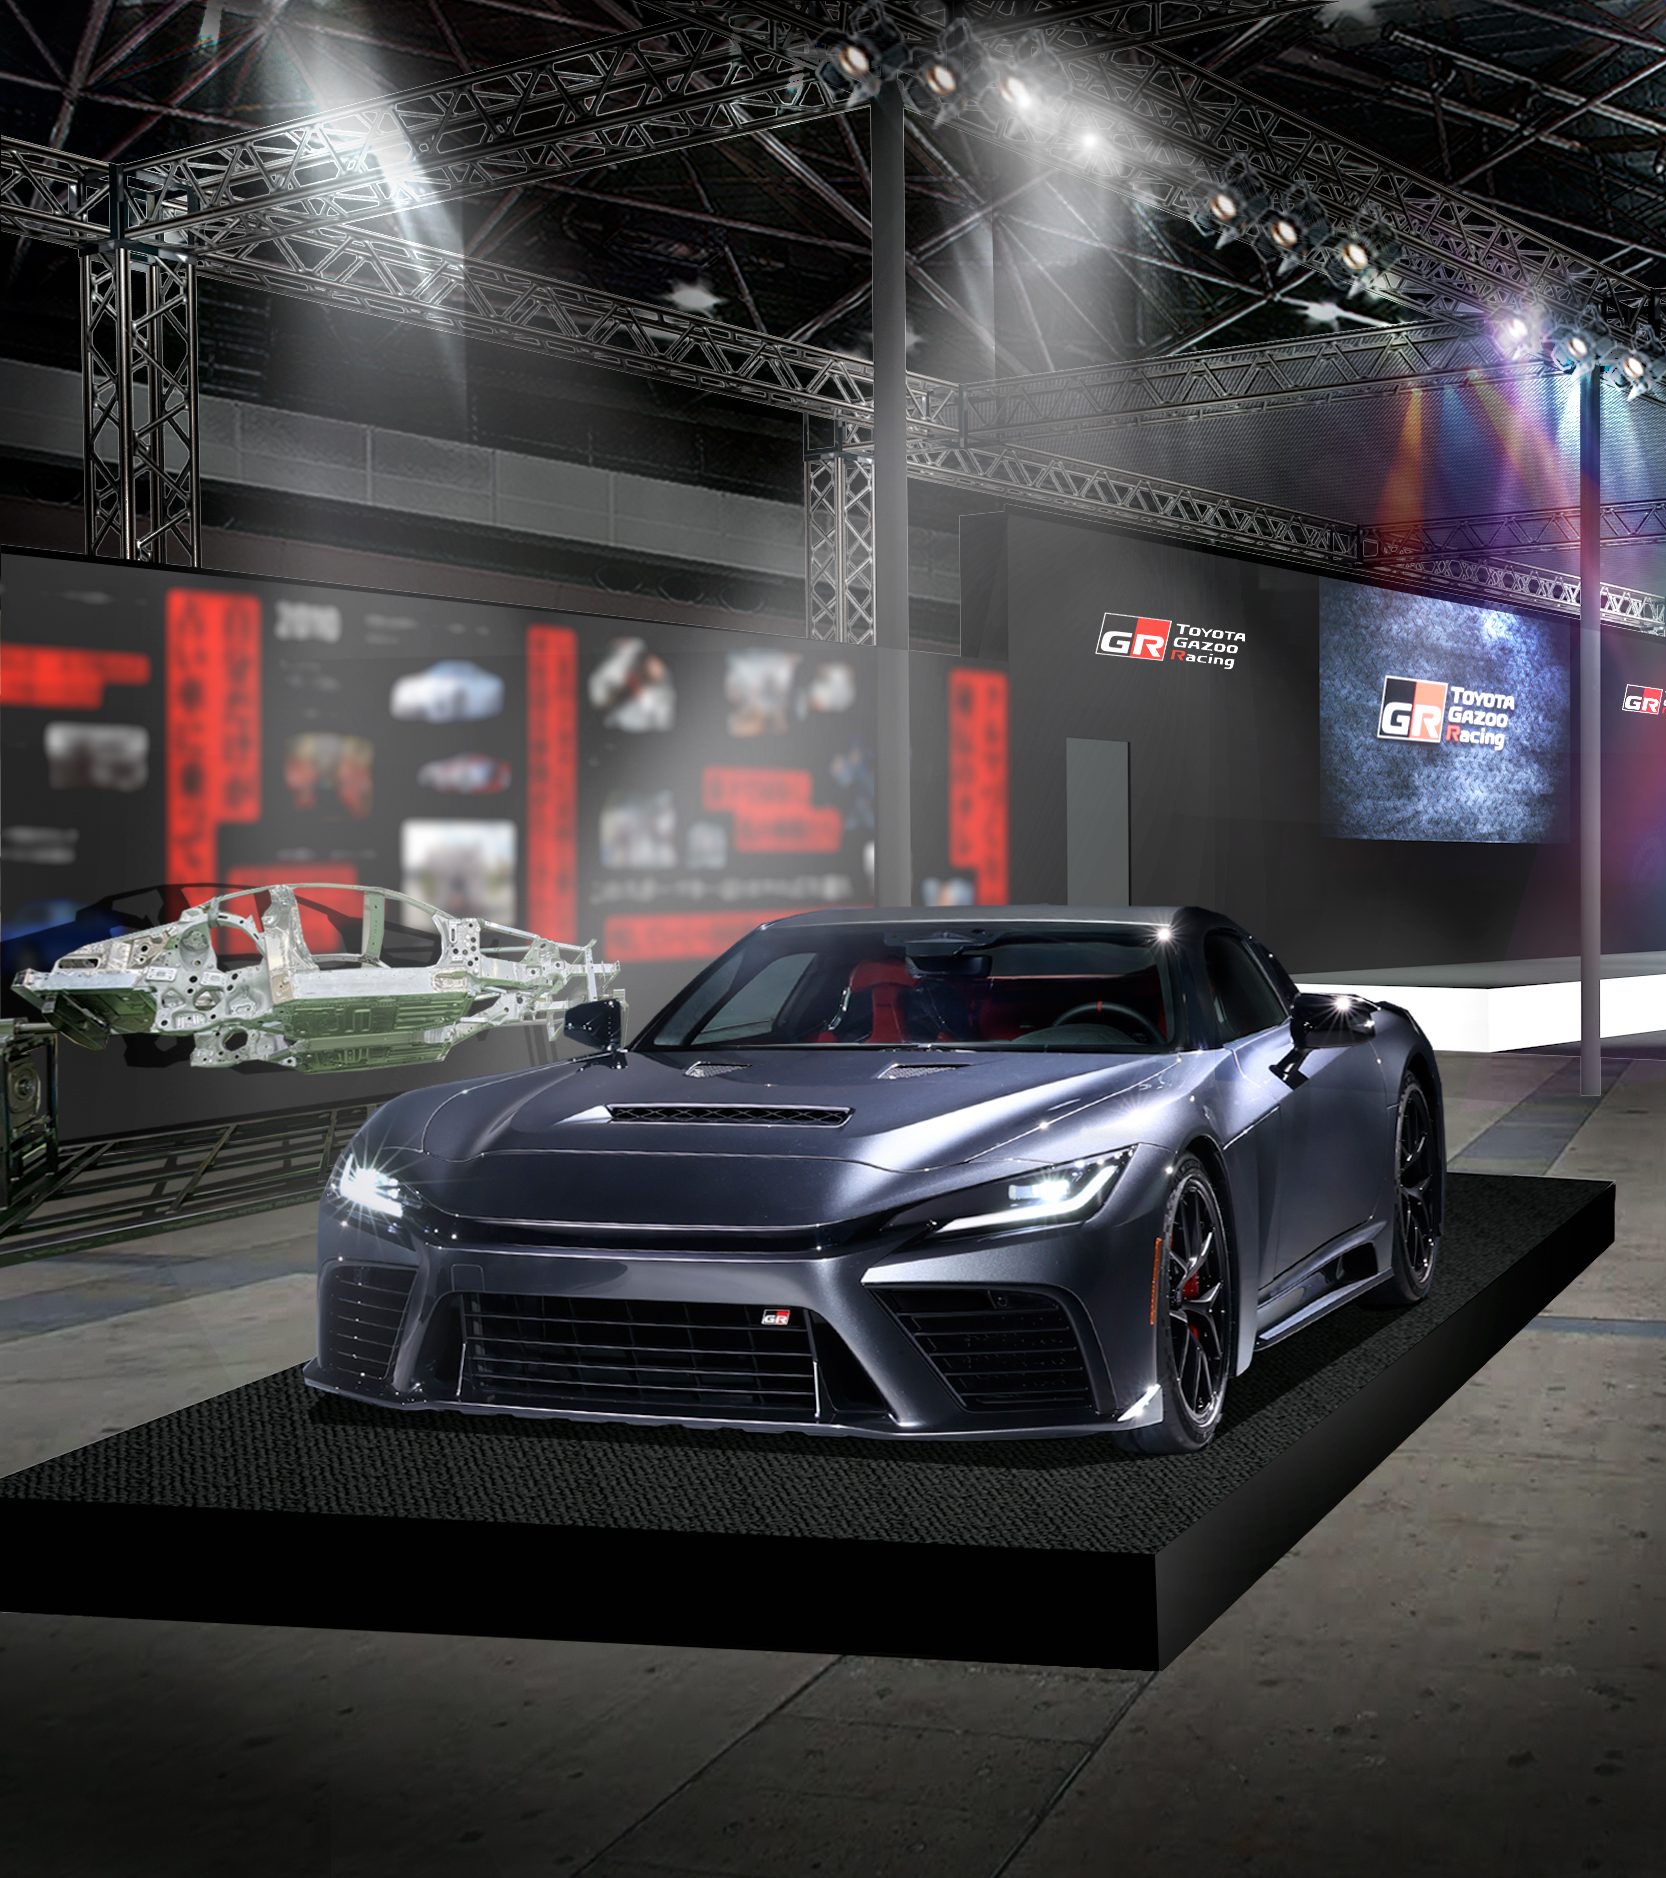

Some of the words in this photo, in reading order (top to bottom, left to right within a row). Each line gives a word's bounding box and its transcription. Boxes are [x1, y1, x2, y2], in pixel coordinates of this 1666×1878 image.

[1100, 630, 1165, 658] GR
[1176, 623, 1246, 643] TOYOTA
[1173, 637, 1239, 654] GAZOO
[1170, 649, 1235, 670] Racing
[1450, 686, 1515, 711] TOYOTA
[1624, 695, 1660, 713] GR
[1381, 702, 1442, 739] GR
[1448, 706, 1508, 728] GAZOO
[1445, 724, 1505, 751] Racing
